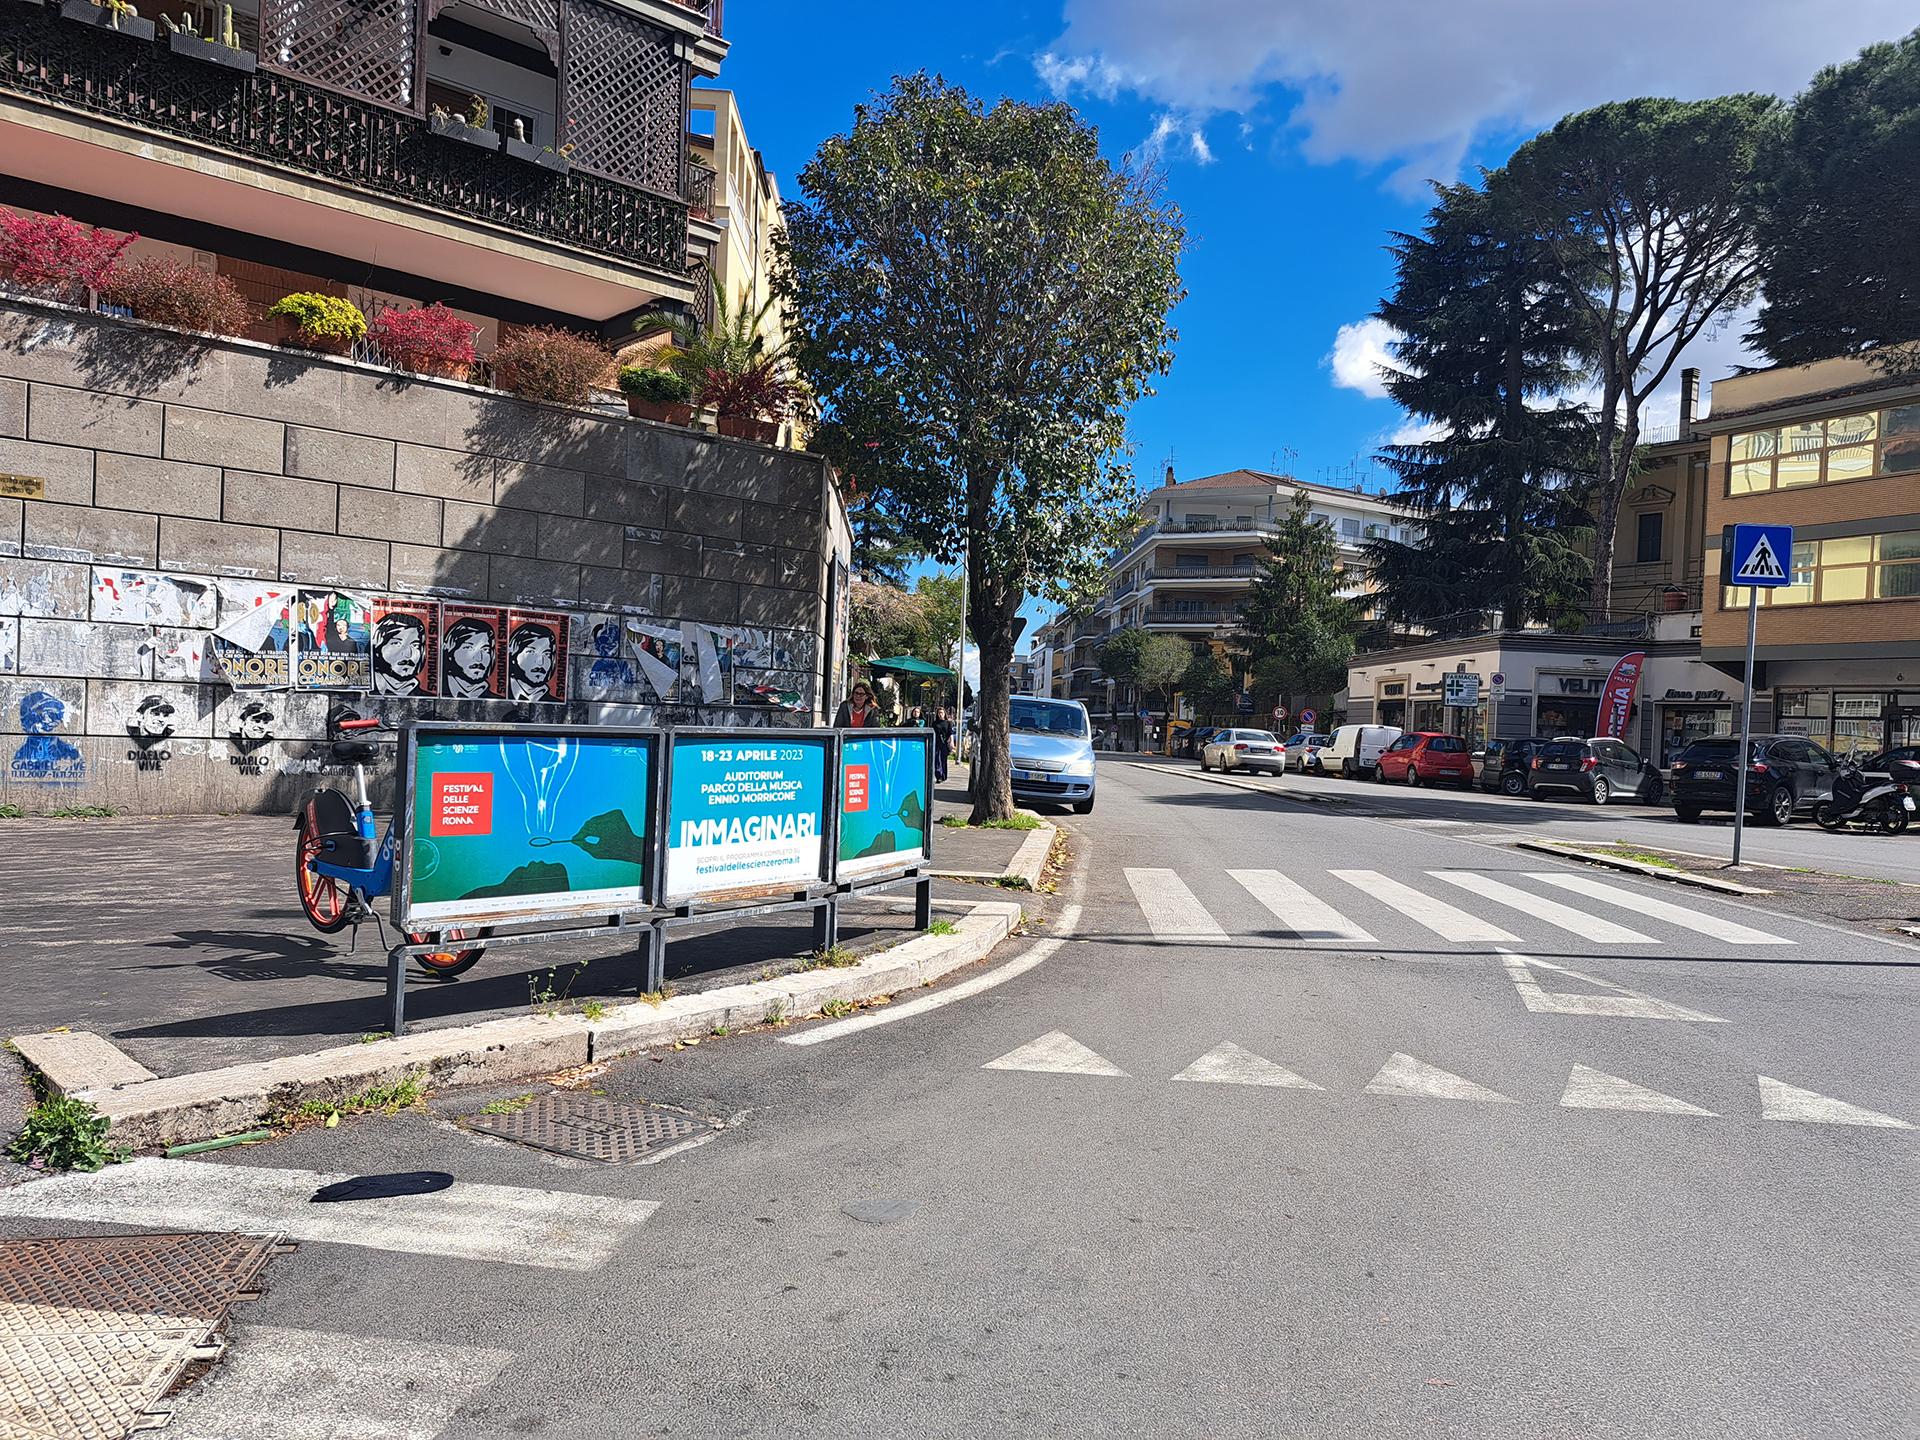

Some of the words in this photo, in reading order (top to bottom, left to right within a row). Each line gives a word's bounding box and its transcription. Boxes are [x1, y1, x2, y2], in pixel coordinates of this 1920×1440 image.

[219, 658, 288, 675] ONORE
[299, 659, 369, 676] ONORE
[1614, 676, 1635, 684] VELITTI
[127, 750, 171, 761] DIABLO
[230, 756, 269, 766] DIABLO
[701, 750, 733, 762] 18-23
[736, 749, 777, 761] APRILE
[780, 749, 803, 760] 2023
[11, 760, 60, 771] GABRIEL
[138, 760, 163, 771] VIVE
[239, 766, 262, 776] VIVE
[724, 770, 784, 782] AUDITORIUM
[443, 784, 484, 793] FESTIVAL
[701, 783, 735, 794] PARCO
[737, 782, 767, 793] DELLA
[769, 780, 803, 791] MUSICA
[443, 795, 469, 804] DELLE
[708, 794, 740, 805] ENNIO
[741, 791, 796, 803] MORRICONE
[442, 805, 480, 815] SCIENZE
[442, 816, 474, 826] ROMA
[681, 812, 816, 848] IMMAGINARI
[726, 852, 763, 861] PROGRAMMA
[764, 848, 793, 857] COMPLETO
[696, 856, 801, 875] festivaldellescienzeroma.it
